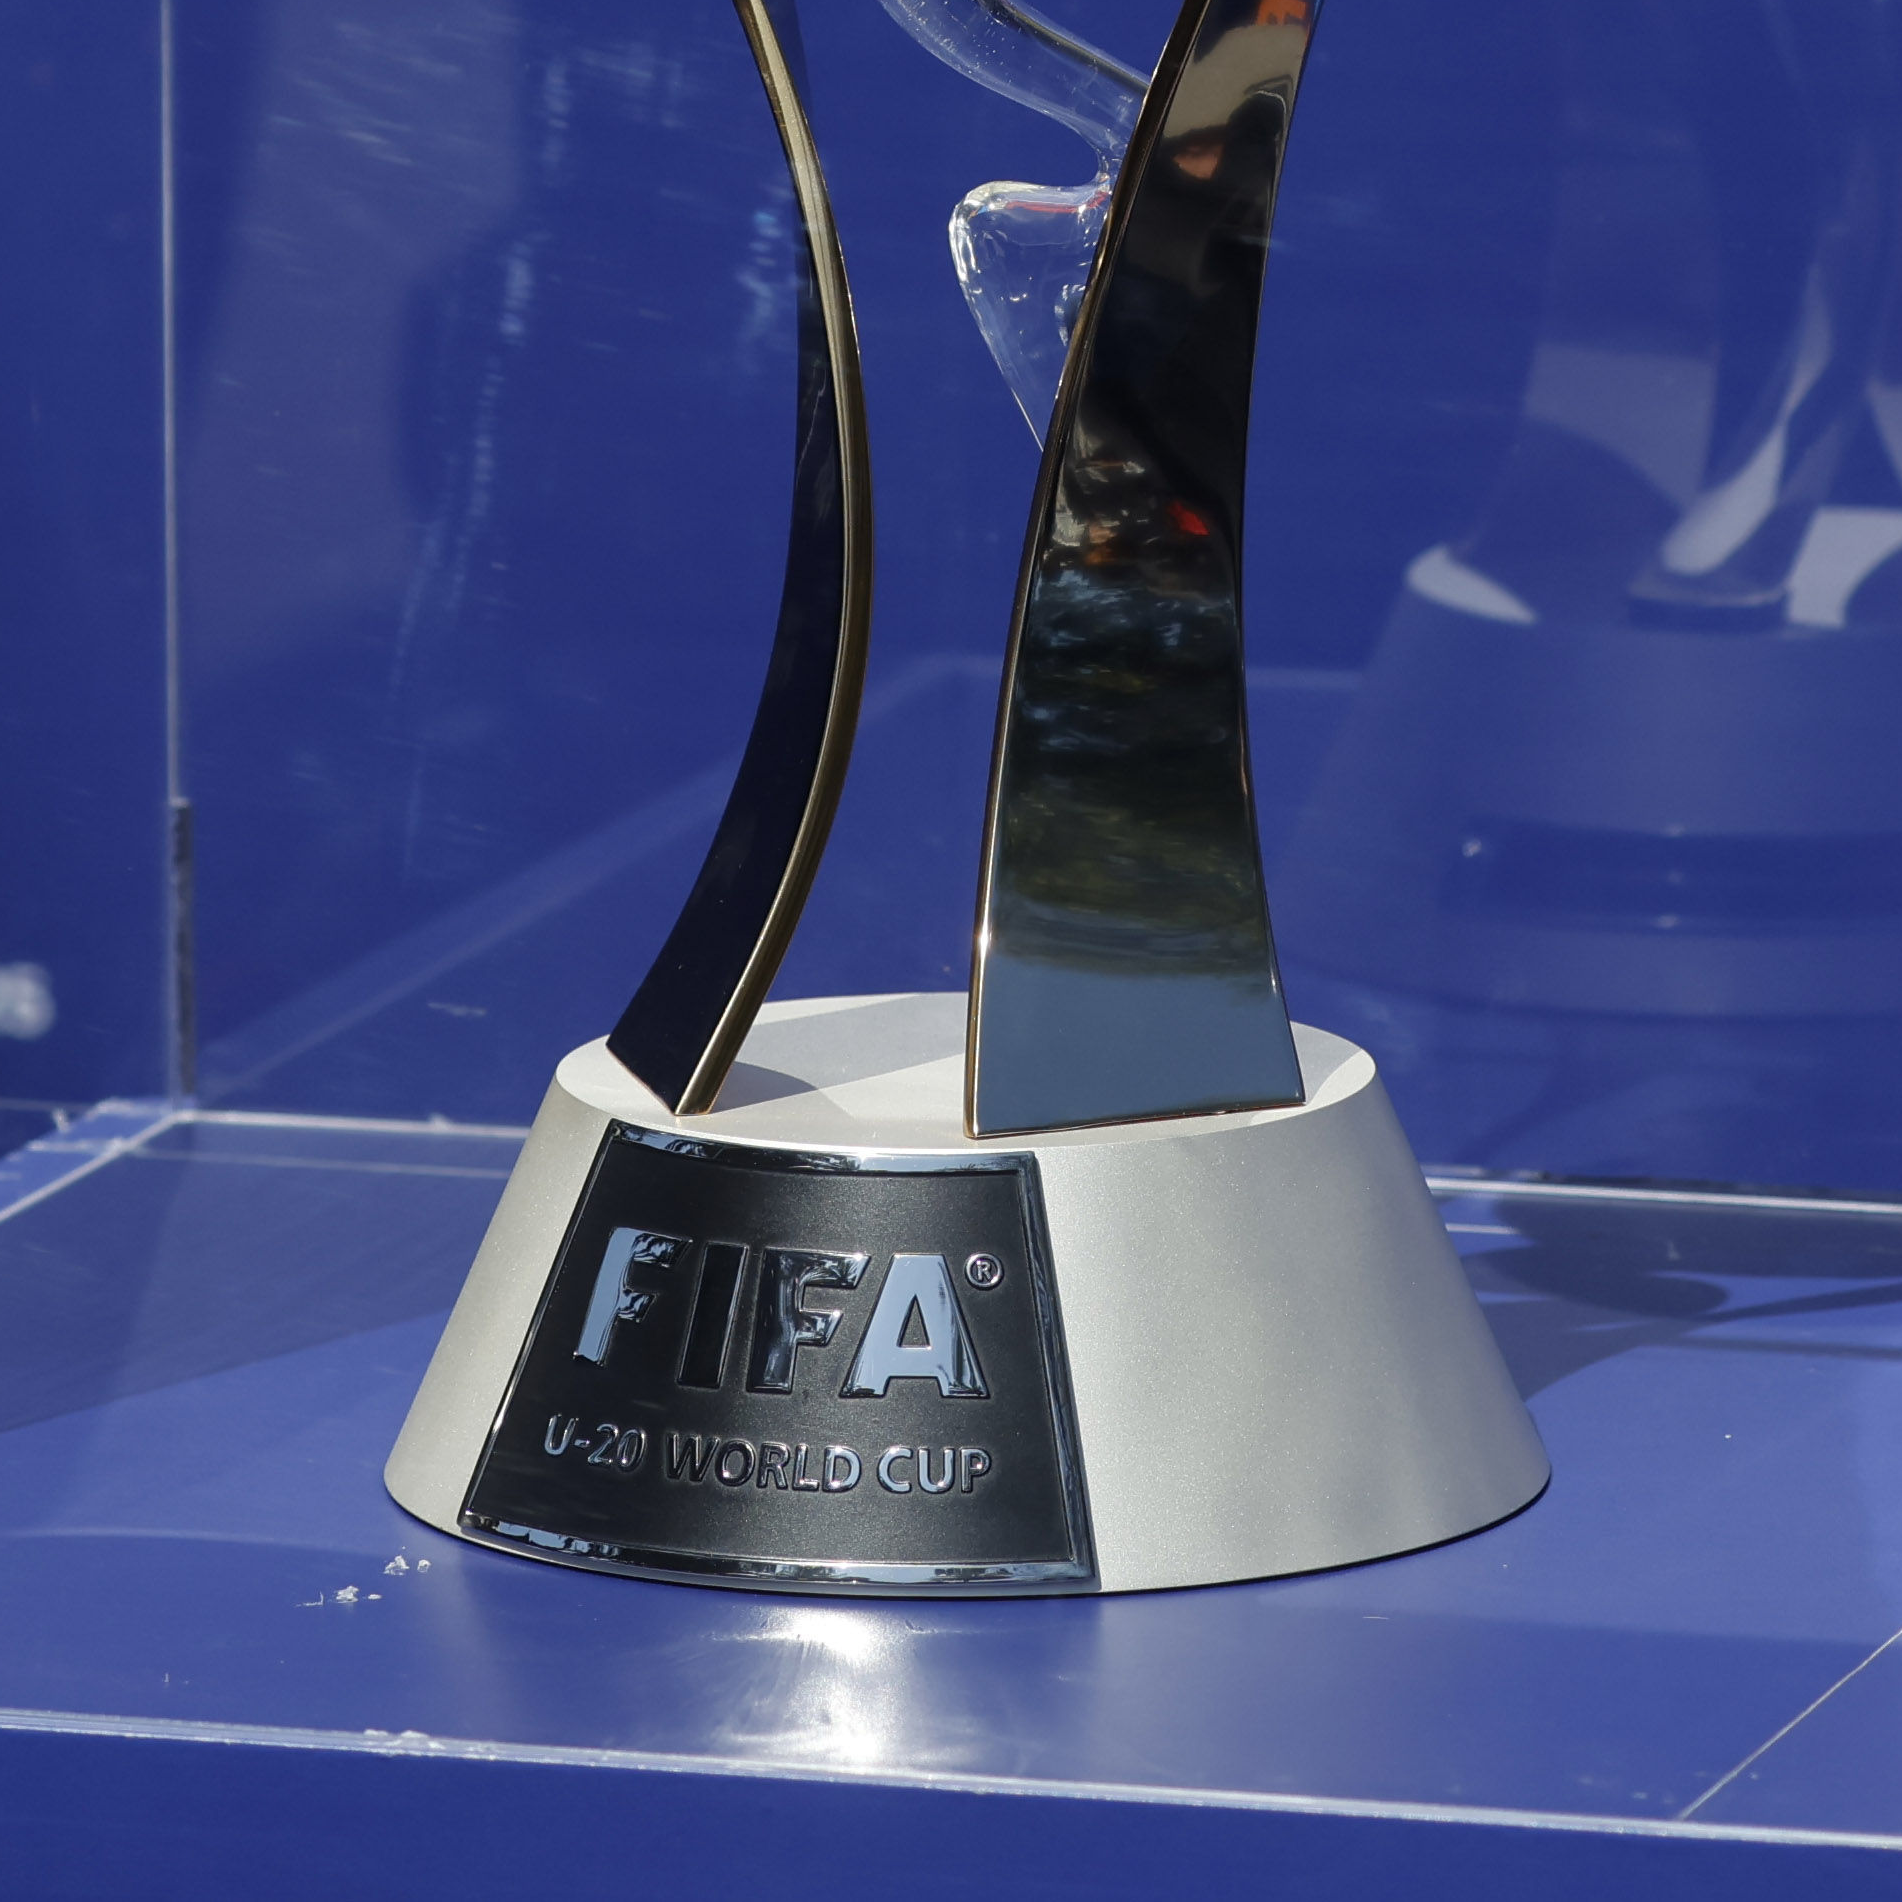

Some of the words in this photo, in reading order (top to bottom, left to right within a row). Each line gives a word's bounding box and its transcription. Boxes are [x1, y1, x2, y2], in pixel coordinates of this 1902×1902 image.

[543, 1412, 648, 1472] U-20
[664, 1432, 864, 1494] WORLD
[876, 1444, 992, 1494] CUP
